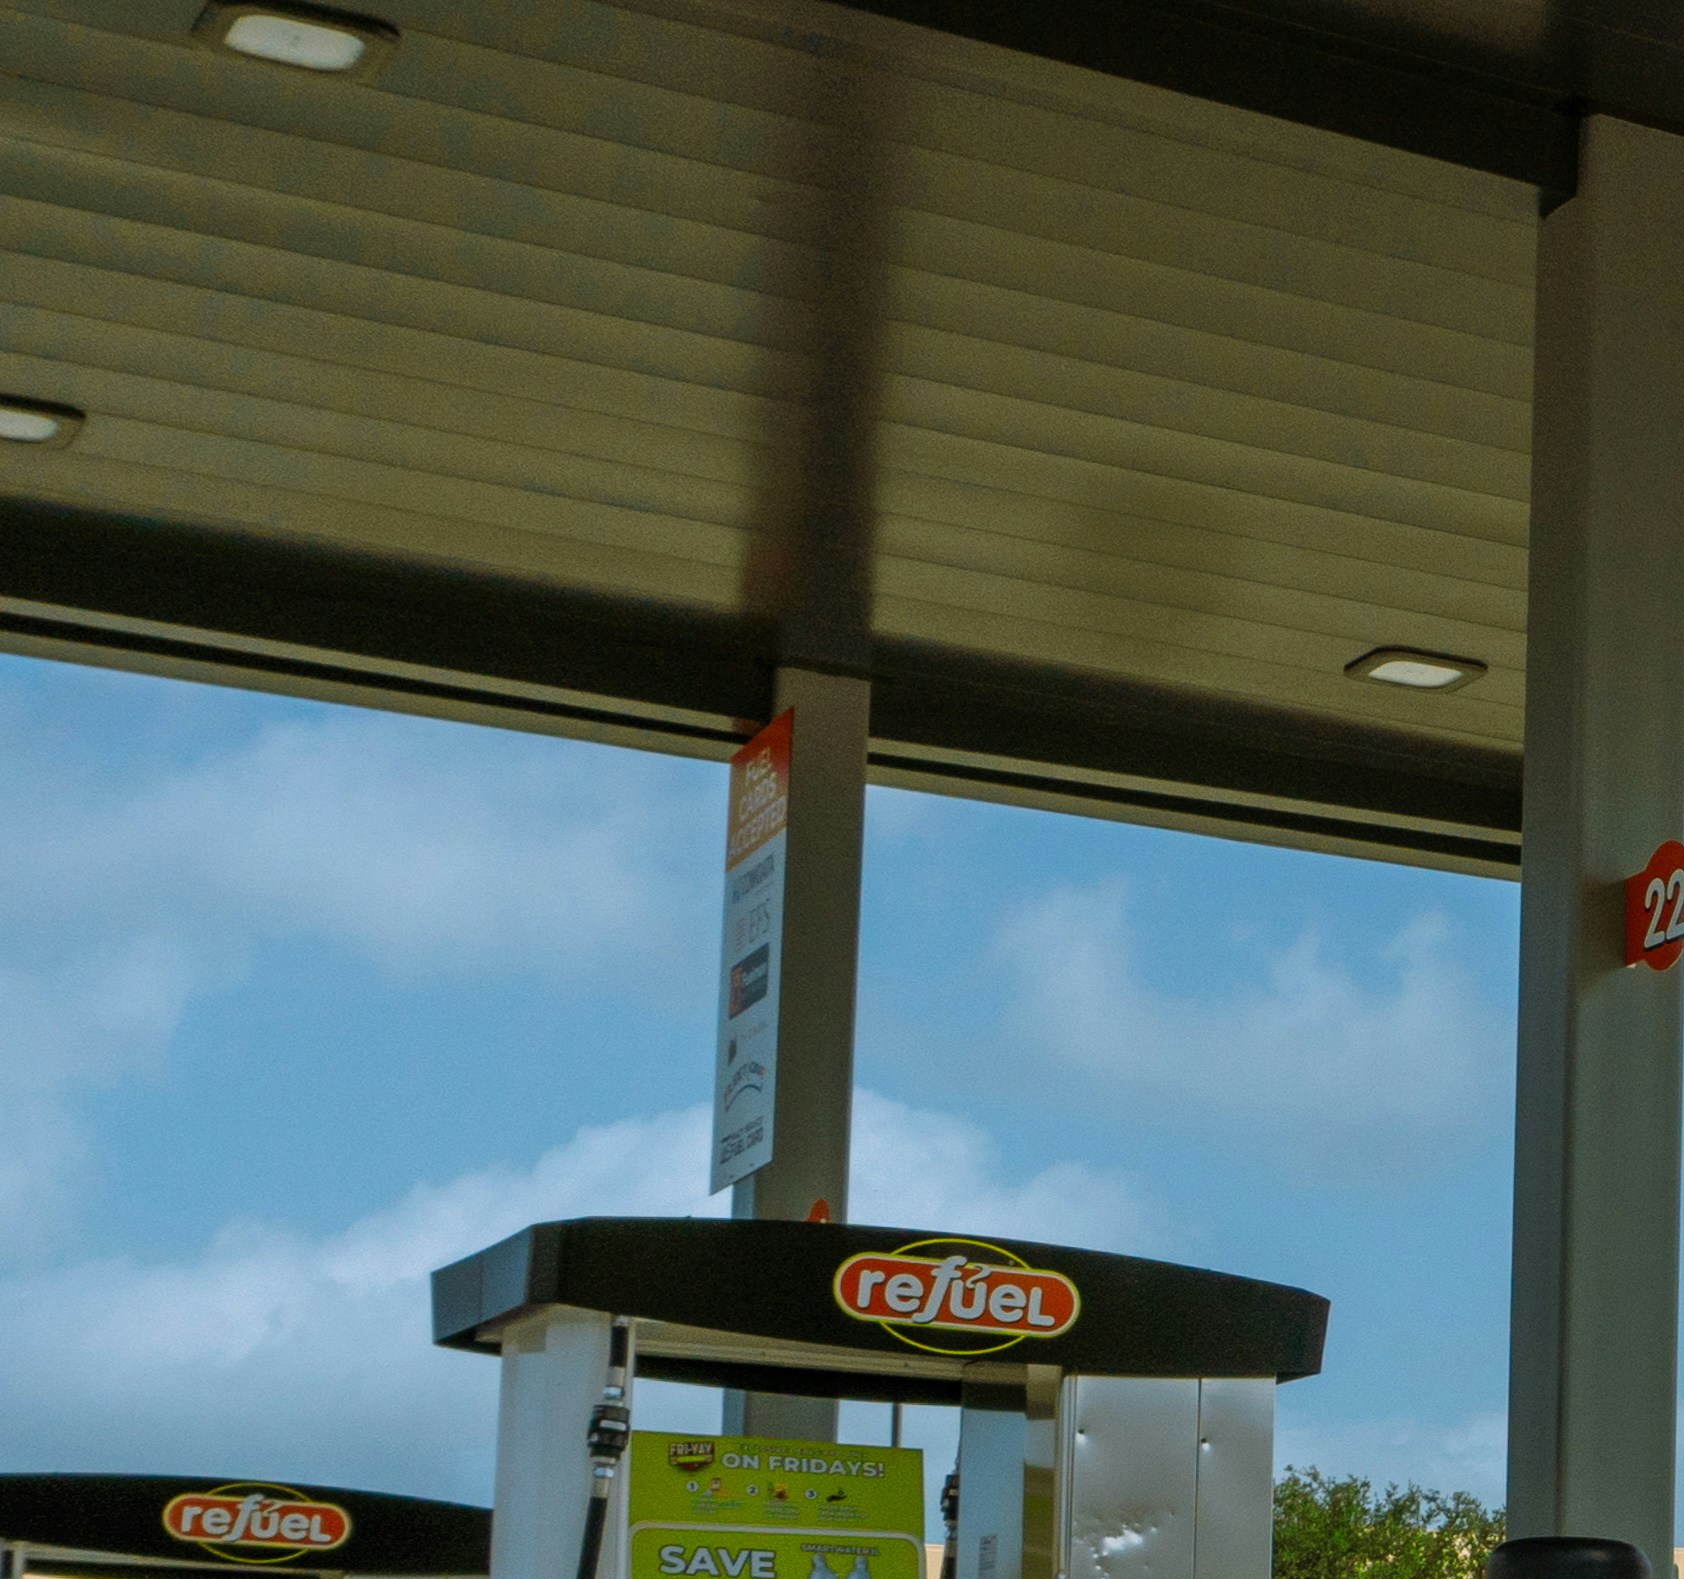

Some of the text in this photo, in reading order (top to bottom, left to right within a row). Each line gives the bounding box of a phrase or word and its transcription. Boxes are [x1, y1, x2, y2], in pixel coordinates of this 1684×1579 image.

[722, 1453, 884, 1478] ON FRIDAYS!
[658, 1545, 776, 1579] SAVE
